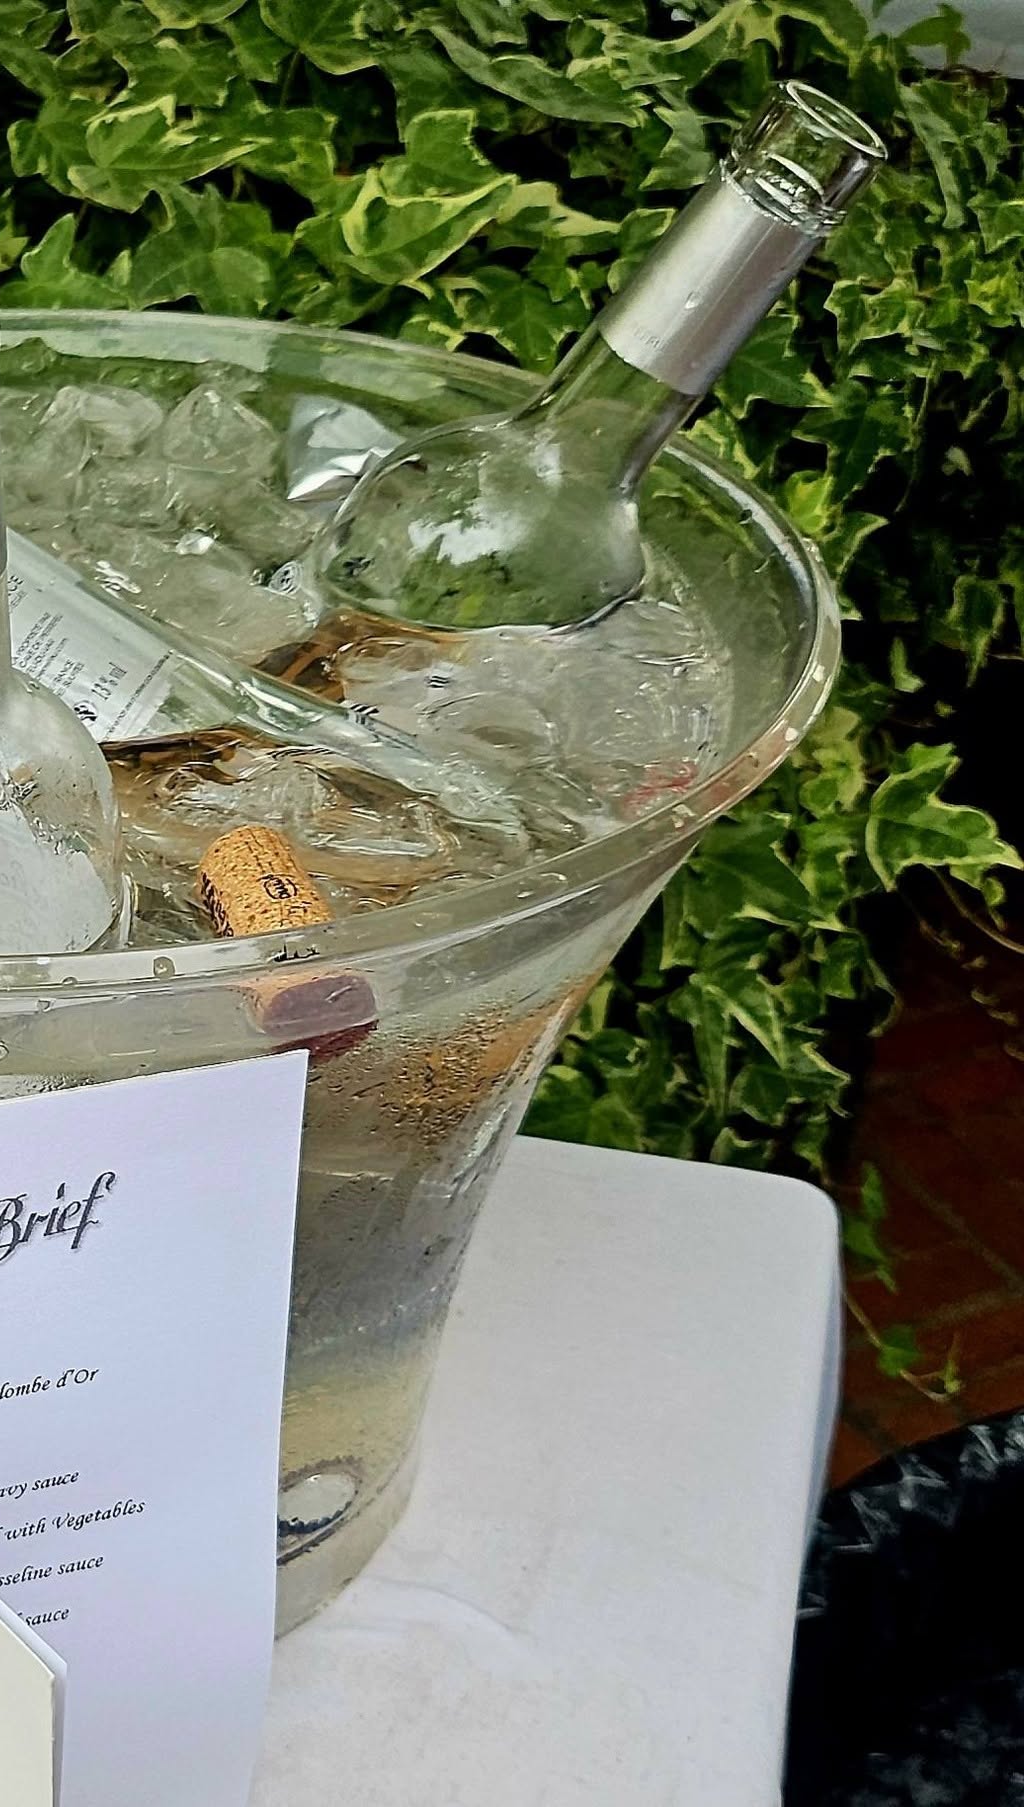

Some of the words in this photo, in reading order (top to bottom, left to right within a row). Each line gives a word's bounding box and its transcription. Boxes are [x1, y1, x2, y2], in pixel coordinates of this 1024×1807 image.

[55, 1368, 100, 1389] d'Or
[31, 1471, 80, 1492] sauce
[4, 1517, 46, 1541] with
[51, 1499, 146, 1531] Vegetables
[57, 1556, 105, 1576] sauce
[25, 1607, 70, 1627] sauce
